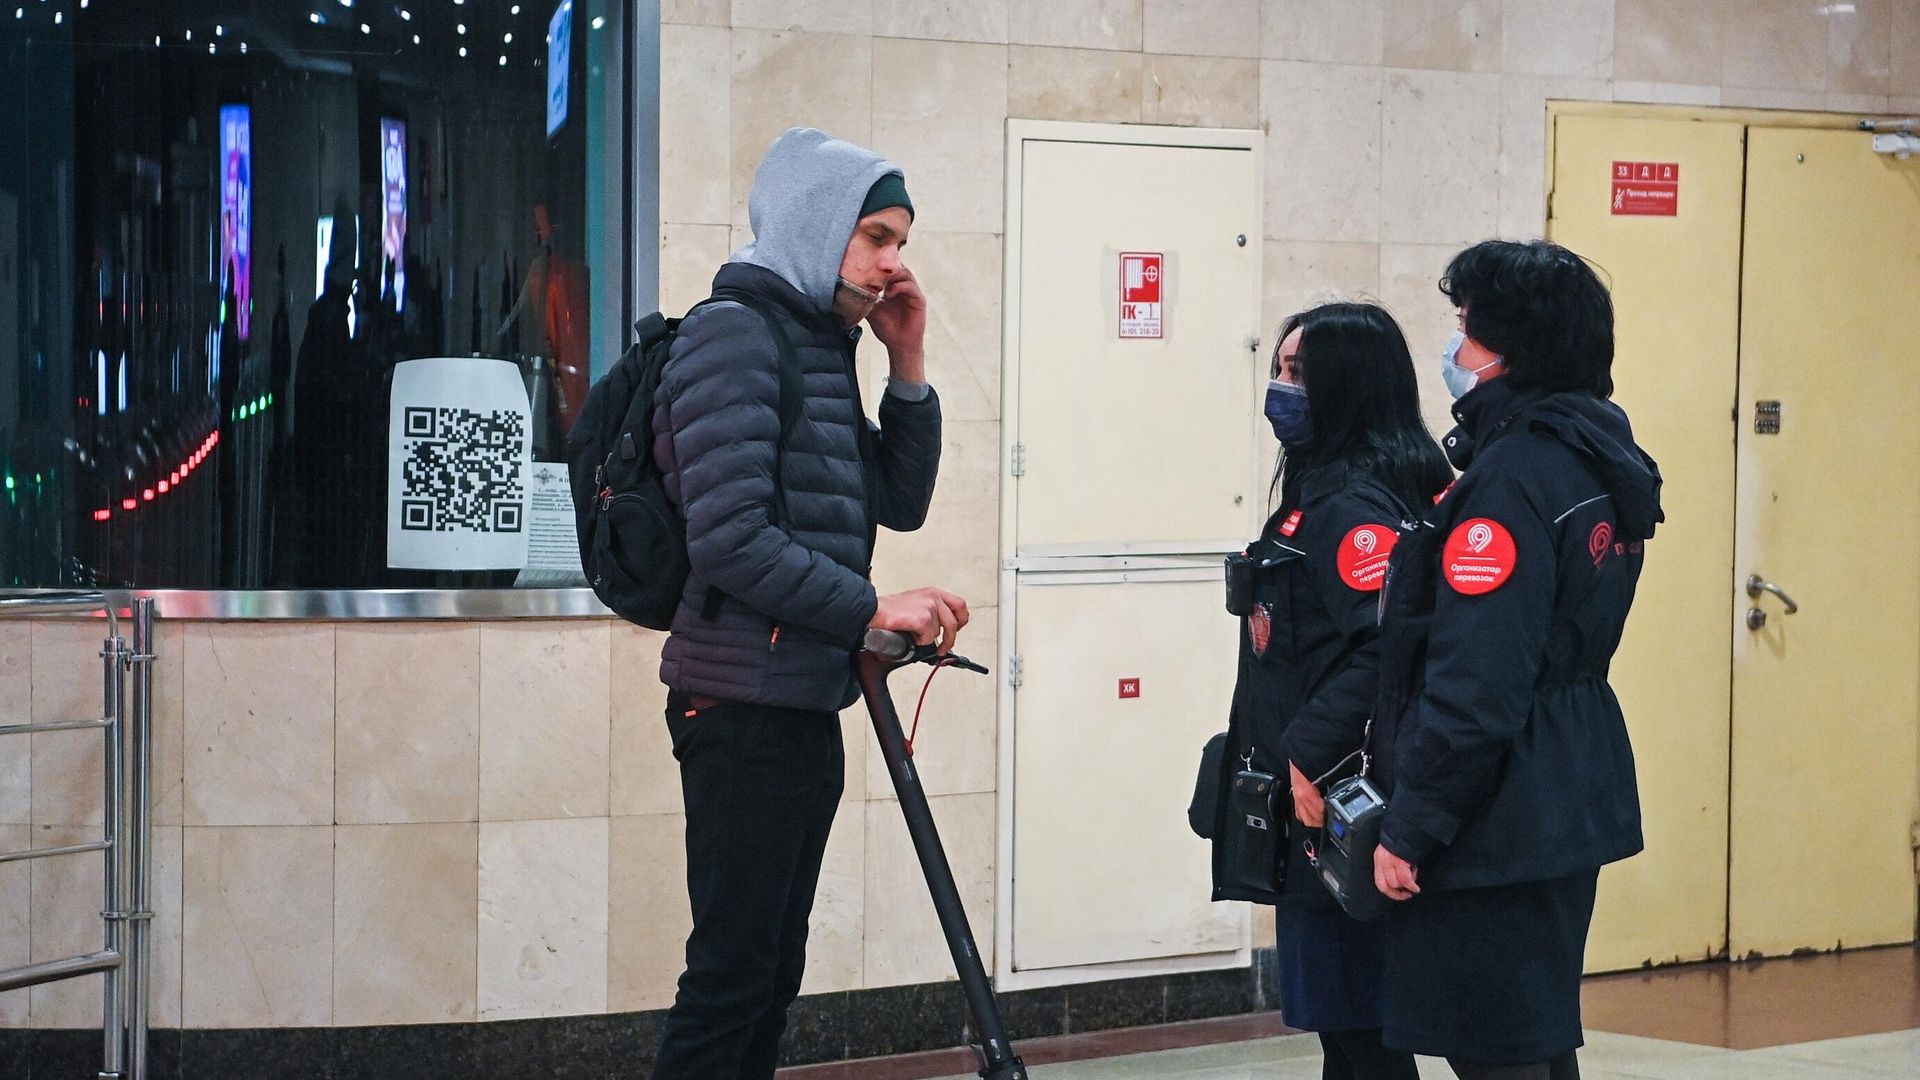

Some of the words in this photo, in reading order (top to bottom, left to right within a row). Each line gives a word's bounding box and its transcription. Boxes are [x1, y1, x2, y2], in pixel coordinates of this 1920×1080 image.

[1450, 563, 1502, 574] Организатор
[1359, 569, 1385, 583] перево
[1453, 574, 1495, 583] перевозок
